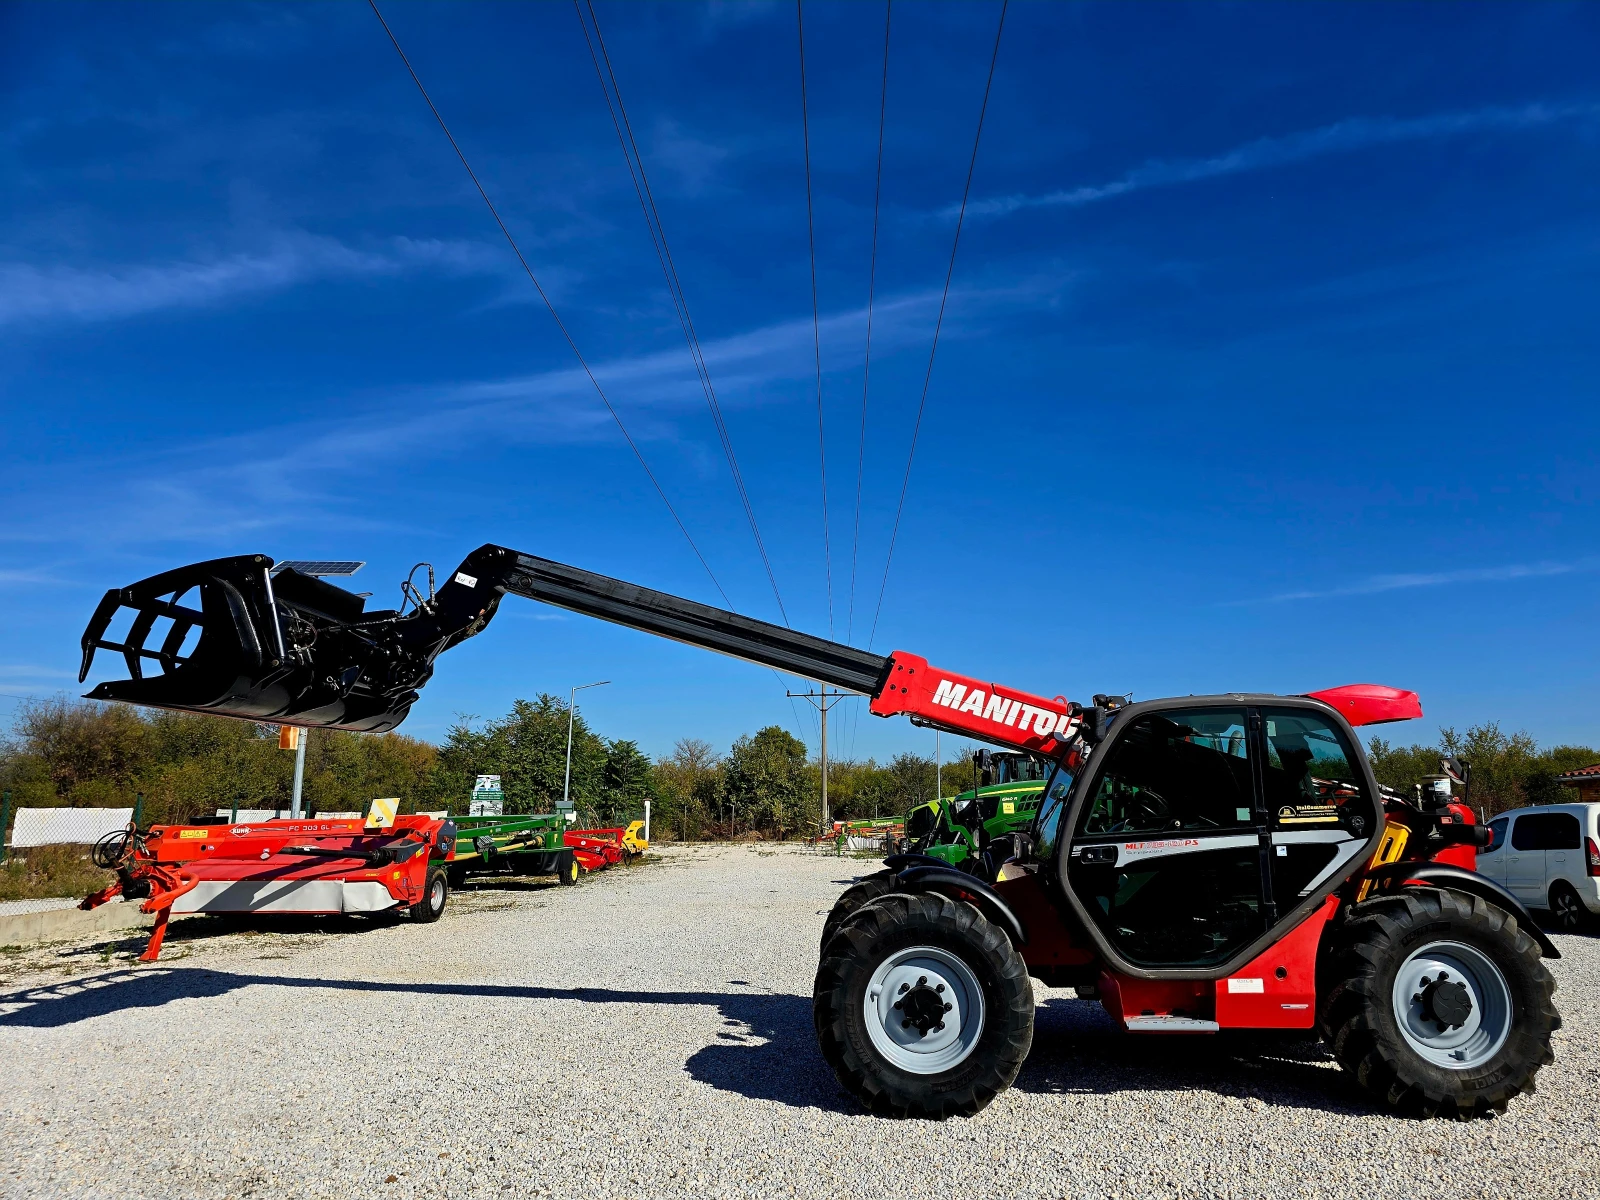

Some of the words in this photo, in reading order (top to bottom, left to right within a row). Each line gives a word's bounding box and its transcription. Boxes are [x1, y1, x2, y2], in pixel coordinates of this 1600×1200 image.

[932, 679, 1081, 740] MANITOU
[1125, 842, 1145, 850] MLT
[1184, 839, 1199, 847] PS
